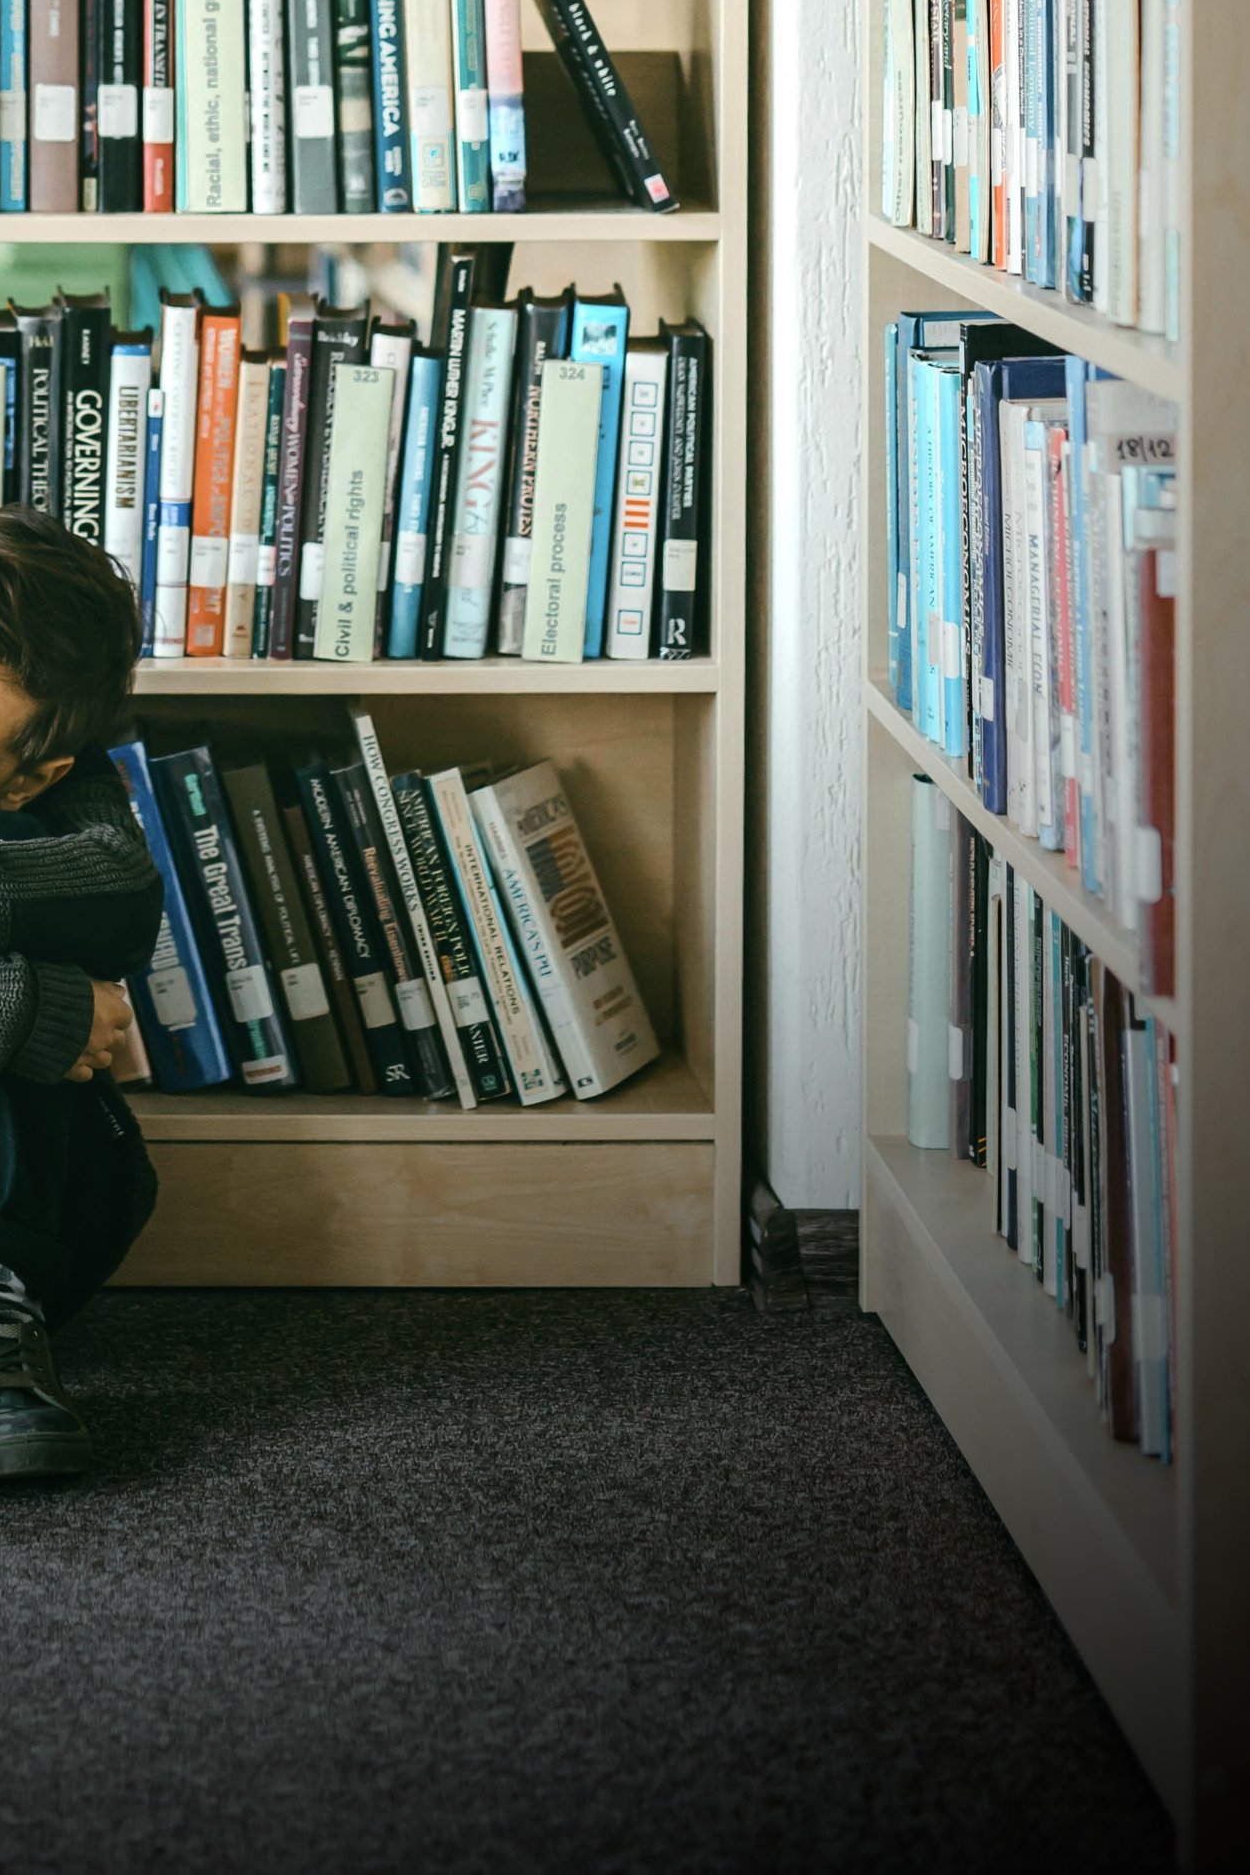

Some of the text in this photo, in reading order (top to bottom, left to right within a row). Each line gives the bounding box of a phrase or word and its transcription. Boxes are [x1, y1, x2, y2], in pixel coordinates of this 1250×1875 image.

[203, 18, 219, 88] national
[379, 39, 400, 137] AMERICA
[32, 368, 49, 457] POLITICAL
[115, 386, 140, 509] LIBERTARIANISM
[465, 418, 499, 508] KING
[335, 470, 365, 658] Civil & political rights
[542, 503, 568, 656] Electoral process
[192, 825, 232, 915] The Great
[309, 778, 370, 960] MODERN AMERICAN DIPLOMACY
[361, 735, 421, 913] HOW CONGRESS WORKS
[463, 844, 521, 1016] INTERNATIONAL RELATIONS
